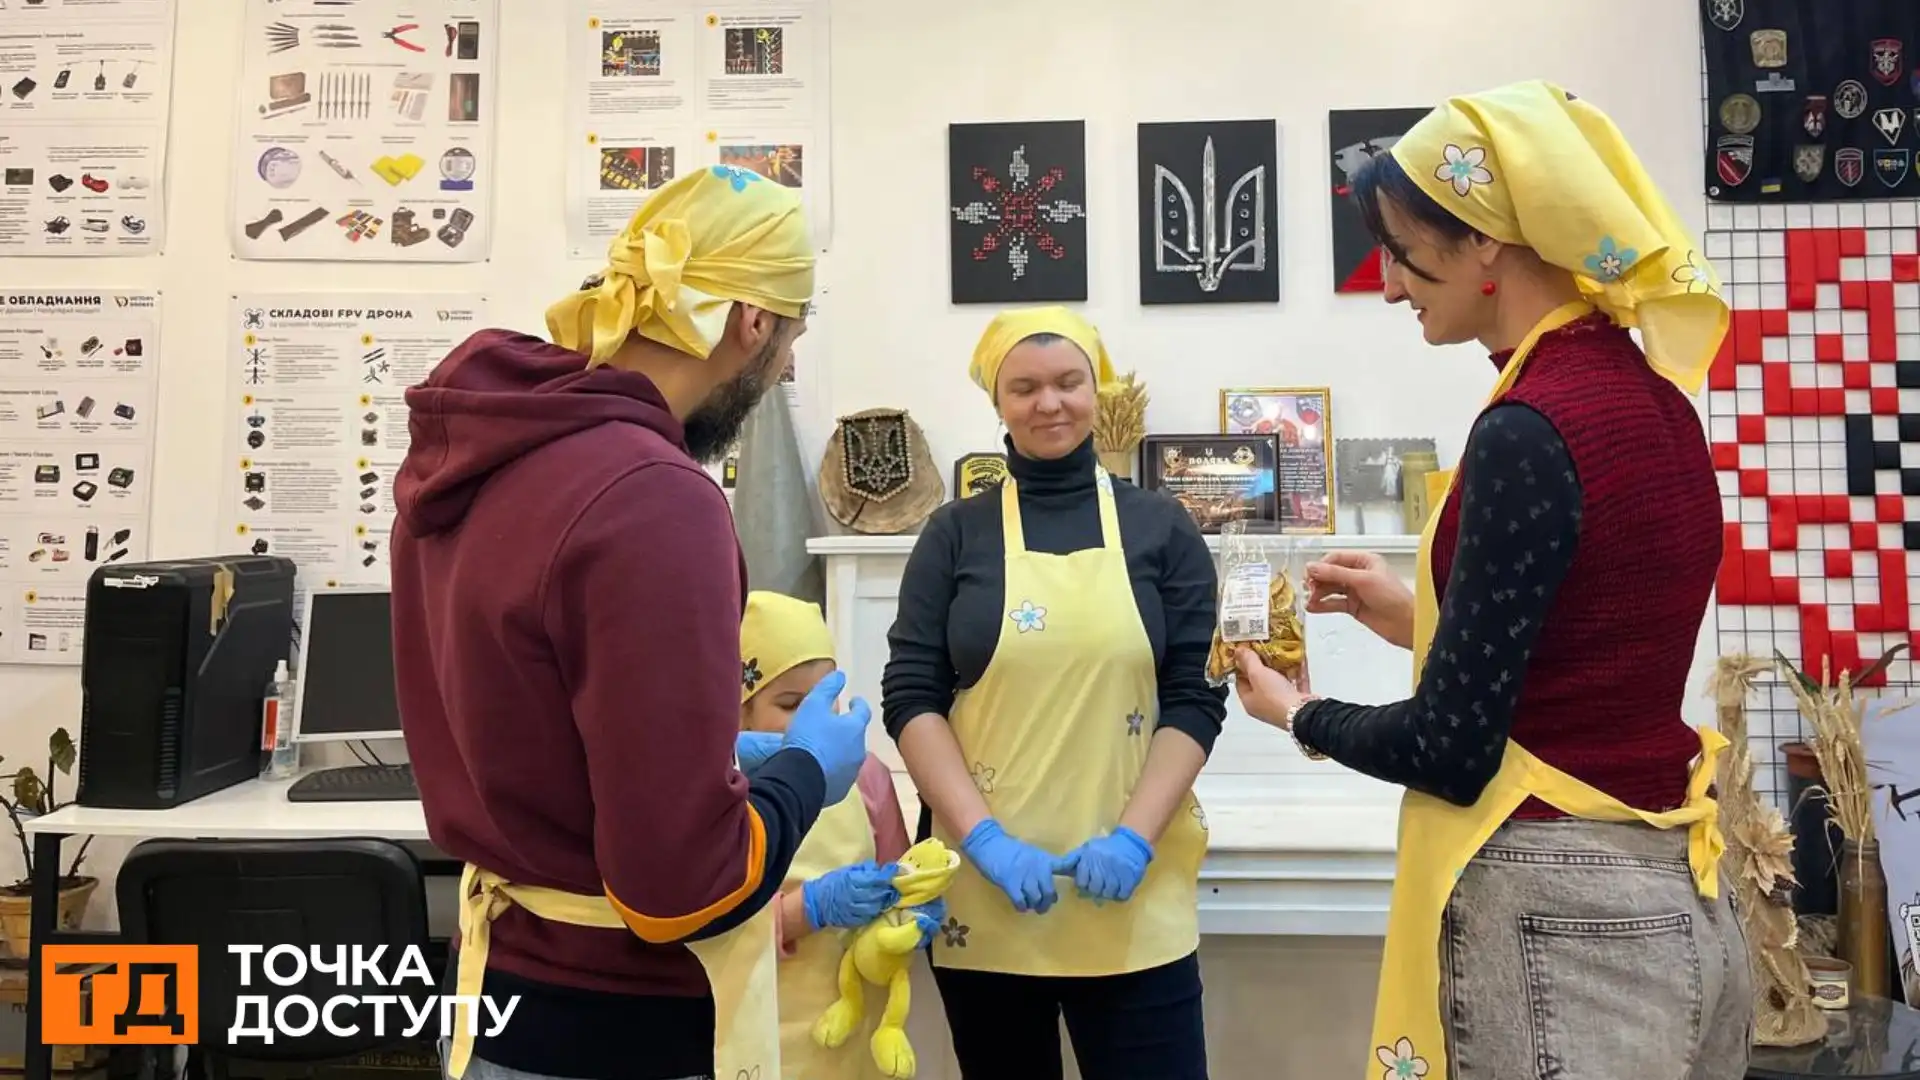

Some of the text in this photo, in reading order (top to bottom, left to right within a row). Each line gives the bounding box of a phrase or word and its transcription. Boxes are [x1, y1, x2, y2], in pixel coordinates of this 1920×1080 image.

[8, 295, 102, 307] ОБЛАДНАННЯ
[269, 309, 413, 320] СКЛАДОВІ FPV ДРОНА
